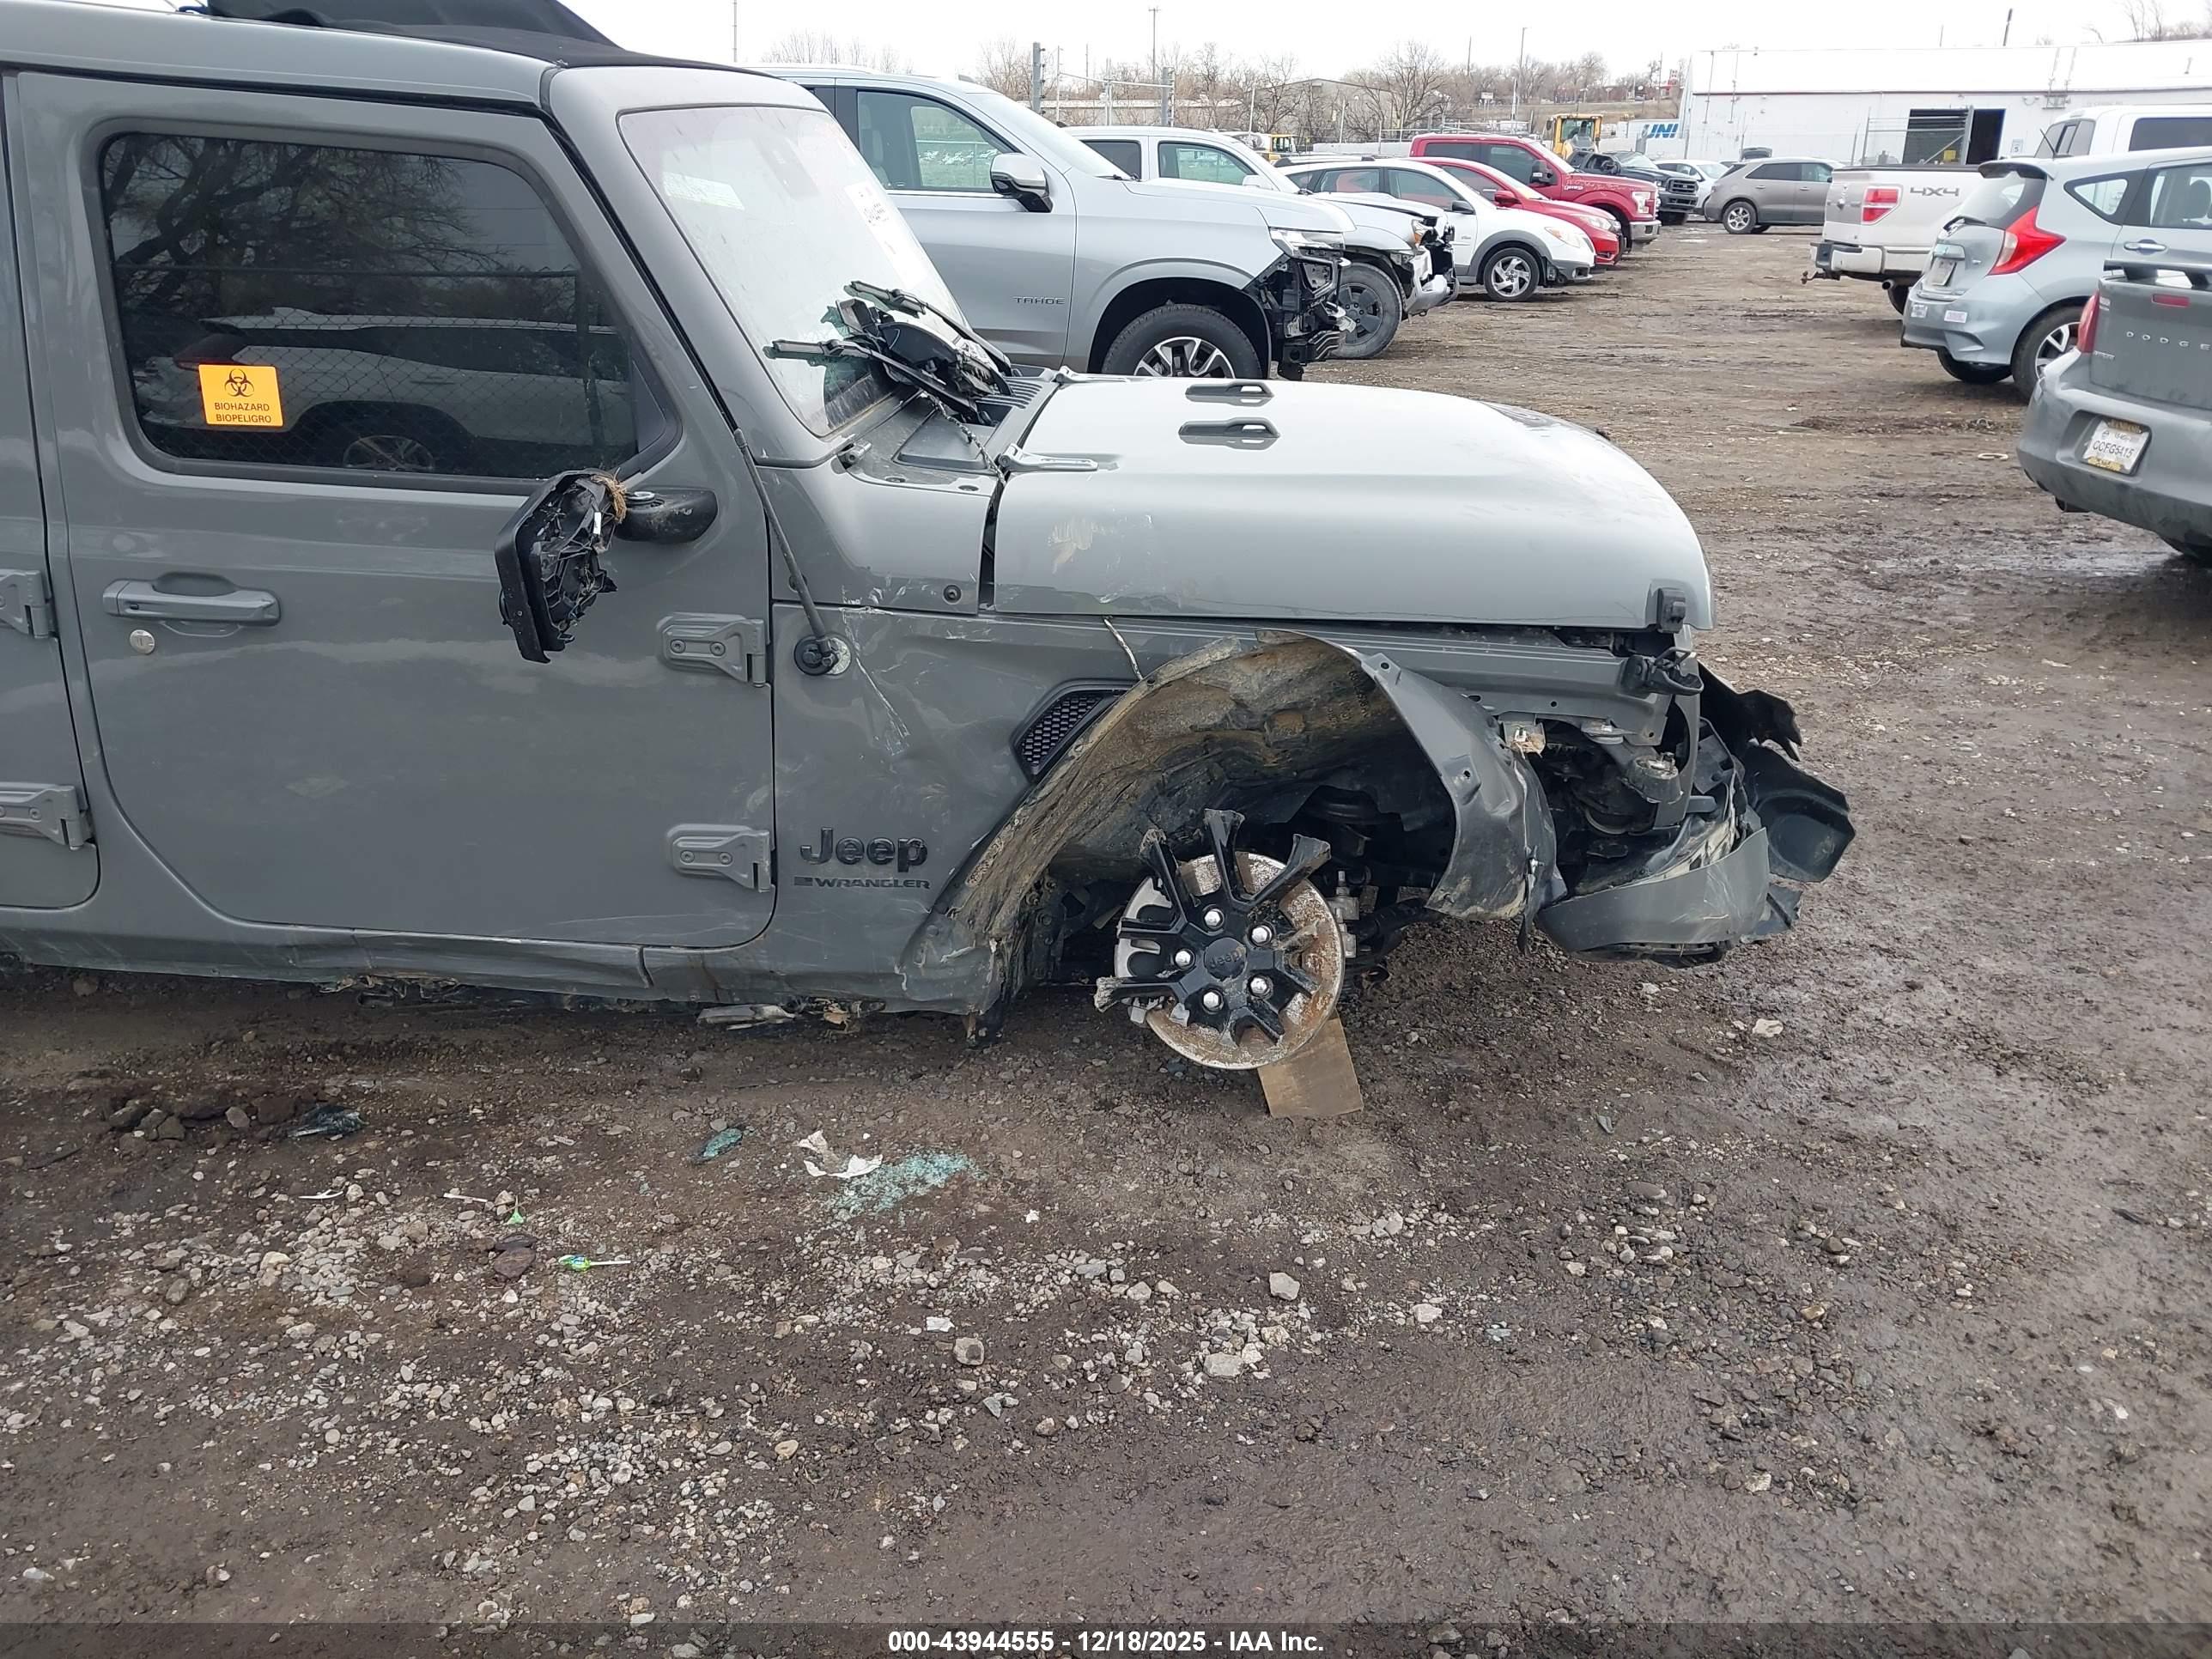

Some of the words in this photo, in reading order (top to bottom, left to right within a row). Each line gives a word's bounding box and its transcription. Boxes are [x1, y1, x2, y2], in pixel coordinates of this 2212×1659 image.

[1012, 296, 1066, 305] TAHOE
[2125, 331, 2211, 350] DODGE
[214, 402, 270, 411] BIOHAZARD
[216, 413, 271, 423] BIOPELIGRO
[799, 827, 928, 873] Jeep
[814, 877, 931, 890] WRANGLER
